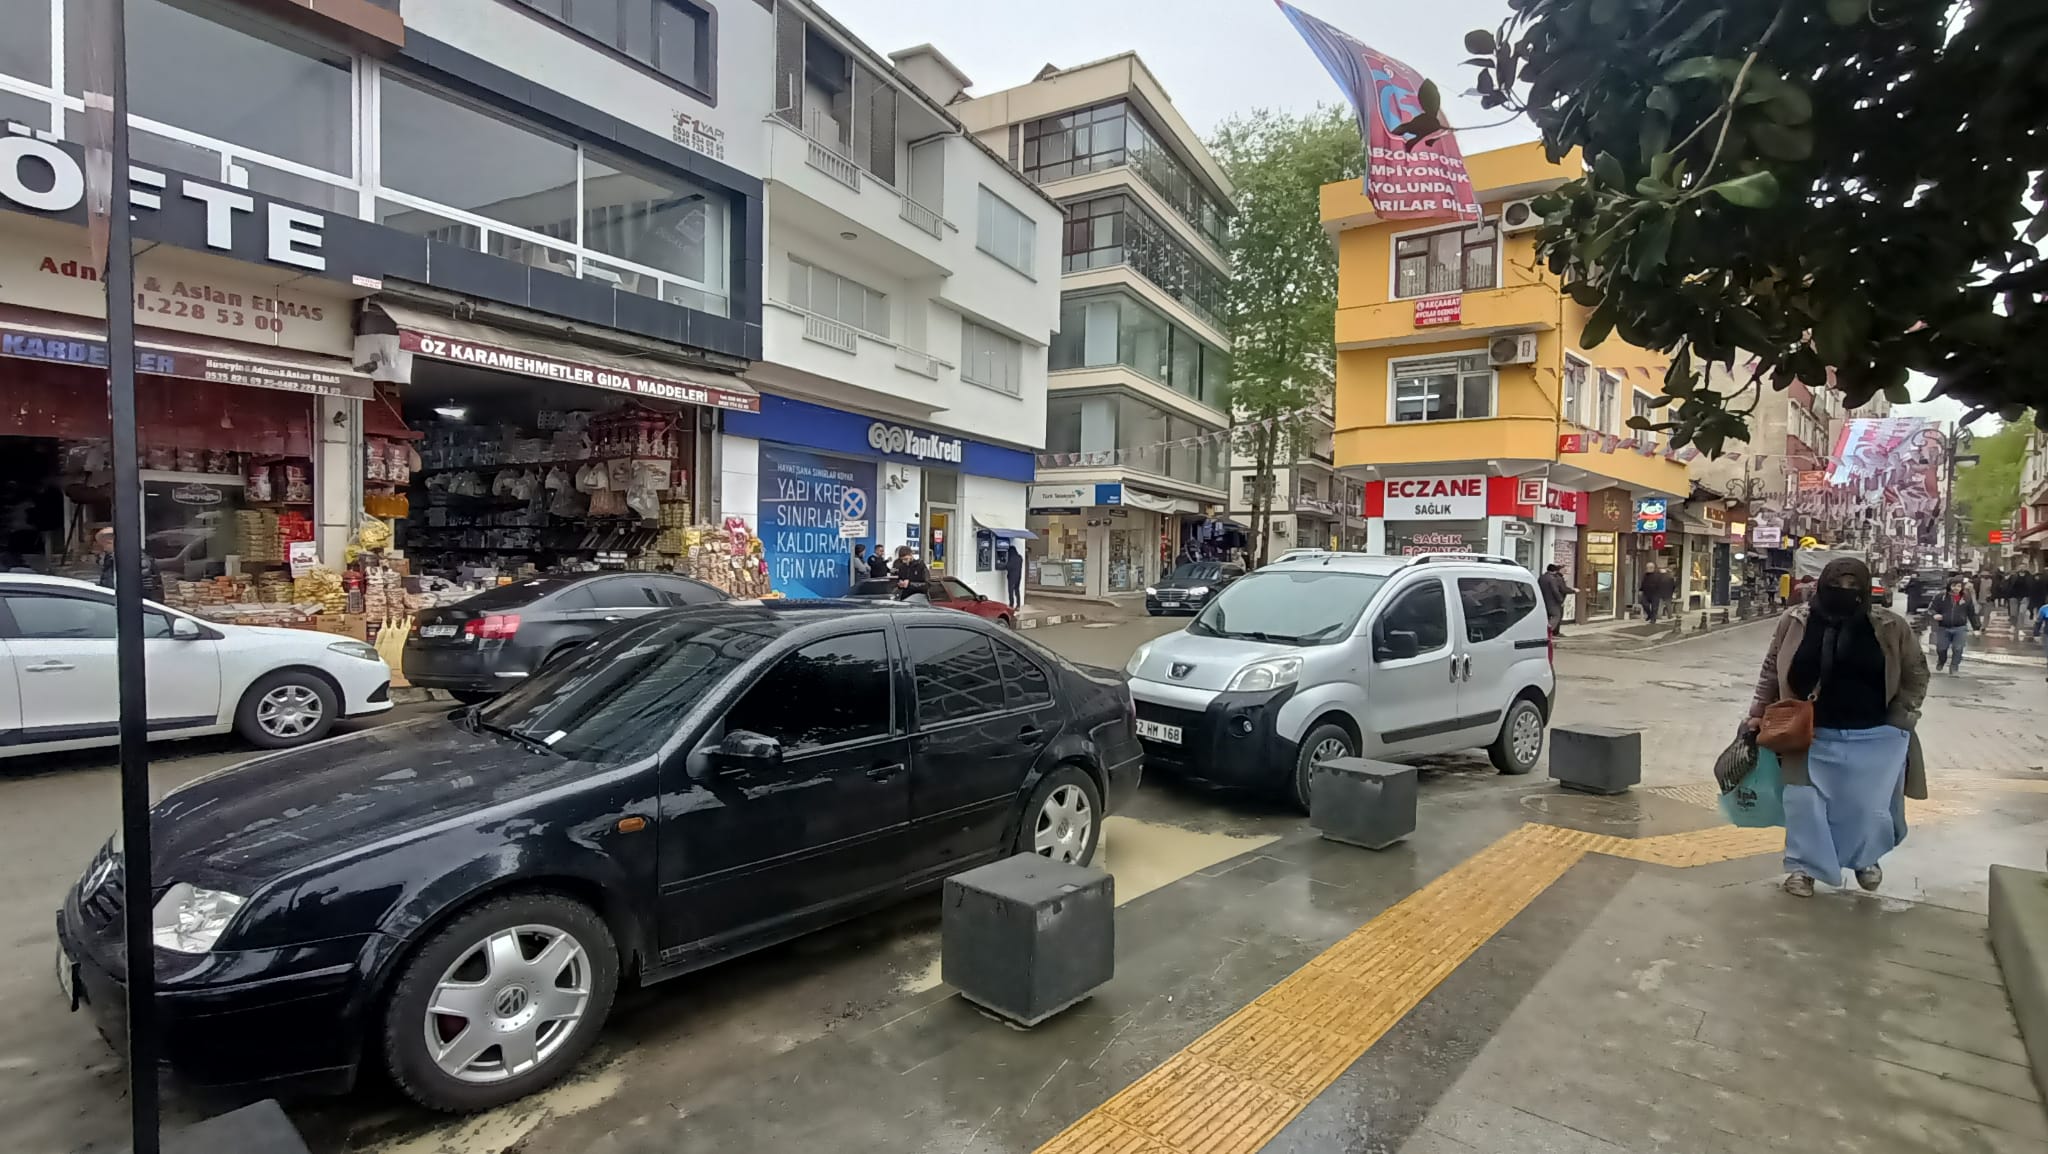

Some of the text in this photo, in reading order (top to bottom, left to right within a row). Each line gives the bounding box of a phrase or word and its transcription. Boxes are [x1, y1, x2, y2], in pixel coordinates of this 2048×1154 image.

[144, 277, 161, 292] &
[172, 281, 242, 307] Aslan
[252, 295, 324, 322] ELMAS
[216, 308, 244, 327] 53
[254, 315, 284, 334] 00
[420, 335, 708, 403] ÖZ KARAMEHMETLER GIDA MADDELERİ
[777, 478, 810, 501] YAPI
[1387, 479, 1482, 498] ECZANE
[1524, 484, 1539, 499] E
[1414, 502, 1452, 515] SAĞLIK
[1412, 532, 1463, 545] SAĞLIK
[809, 559, 839, 578] VAR.
[1136, 720, 1180, 742] 2 HM 168
